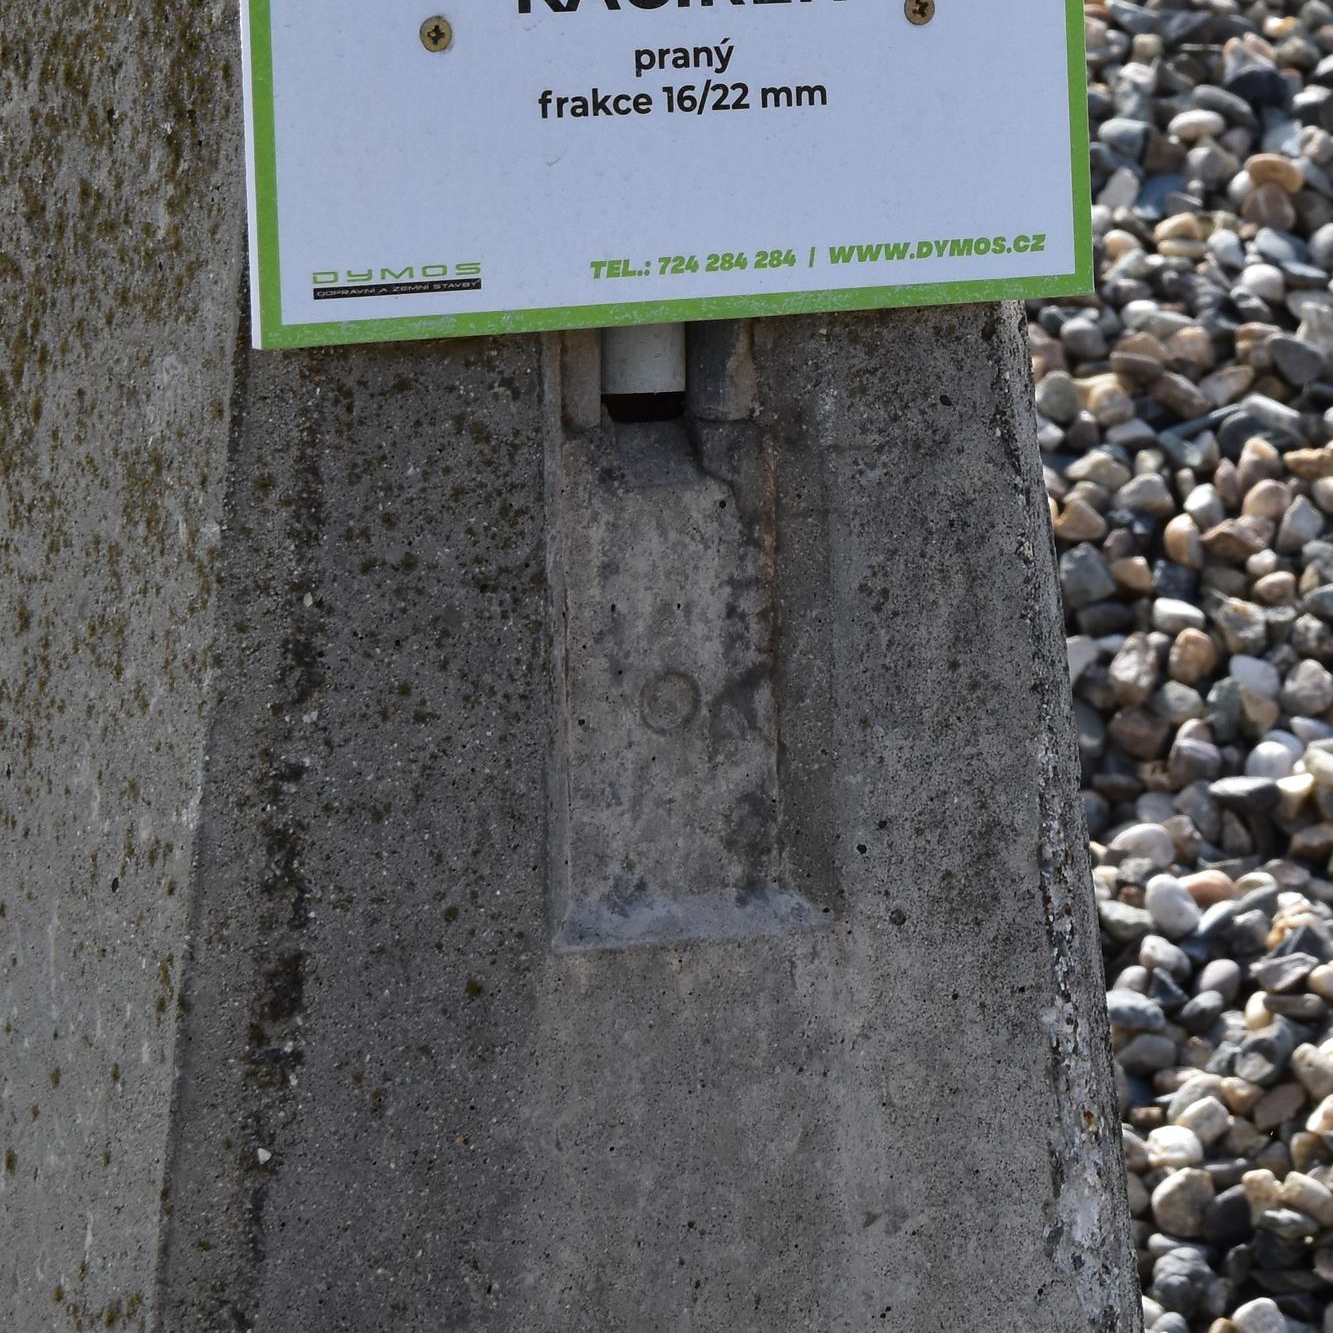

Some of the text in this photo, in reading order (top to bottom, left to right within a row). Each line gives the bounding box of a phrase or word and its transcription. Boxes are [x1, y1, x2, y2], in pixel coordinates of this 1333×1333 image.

[634, 37, 734, 78] praný
[538, 79, 828, 119] frakce 16/22 mm
[312, 262, 481, 284] DYMOS
[590, 259, 652, 279] TEL.:
[658, 255, 700, 275] 724
[705, 252, 748, 272] 284
[753, 249, 797, 269] 284
[828, 233, 1046, 265] WWW.DYMOS.CZ
